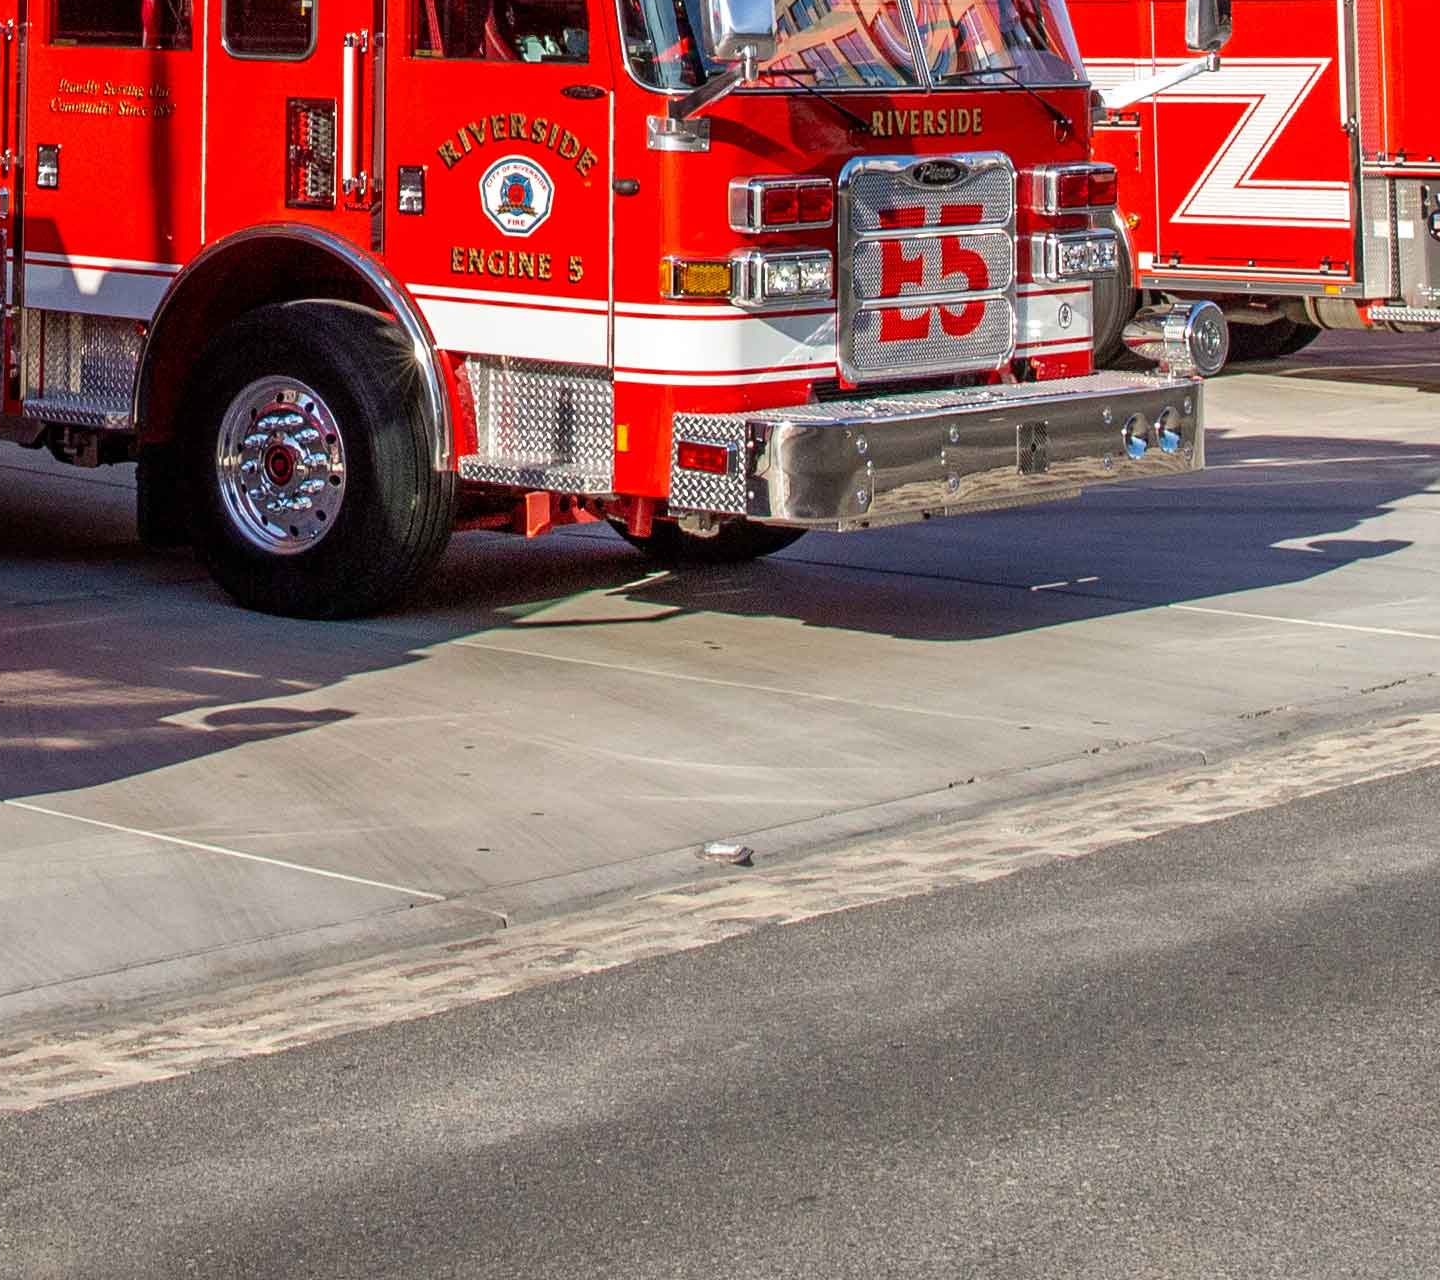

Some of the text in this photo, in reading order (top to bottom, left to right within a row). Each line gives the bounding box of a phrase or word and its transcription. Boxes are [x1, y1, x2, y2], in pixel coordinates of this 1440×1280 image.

[59, 78, 100, 96] Proudly
[103, 81, 145, 99] Serving
[50, 97, 113, 116] Community
[117, 100, 148, 117] Since
[871, 108, 983, 137] RIVERSIDE
[438, 112, 599, 178] RIVERSIDE
[486, 164, 548, 193] CITY OF RIVERSIDE
[507, 218, 526, 227] FIRE
[451, 246, 585, 283] ENGINE 5
[878, 204, 990, 344] E5
